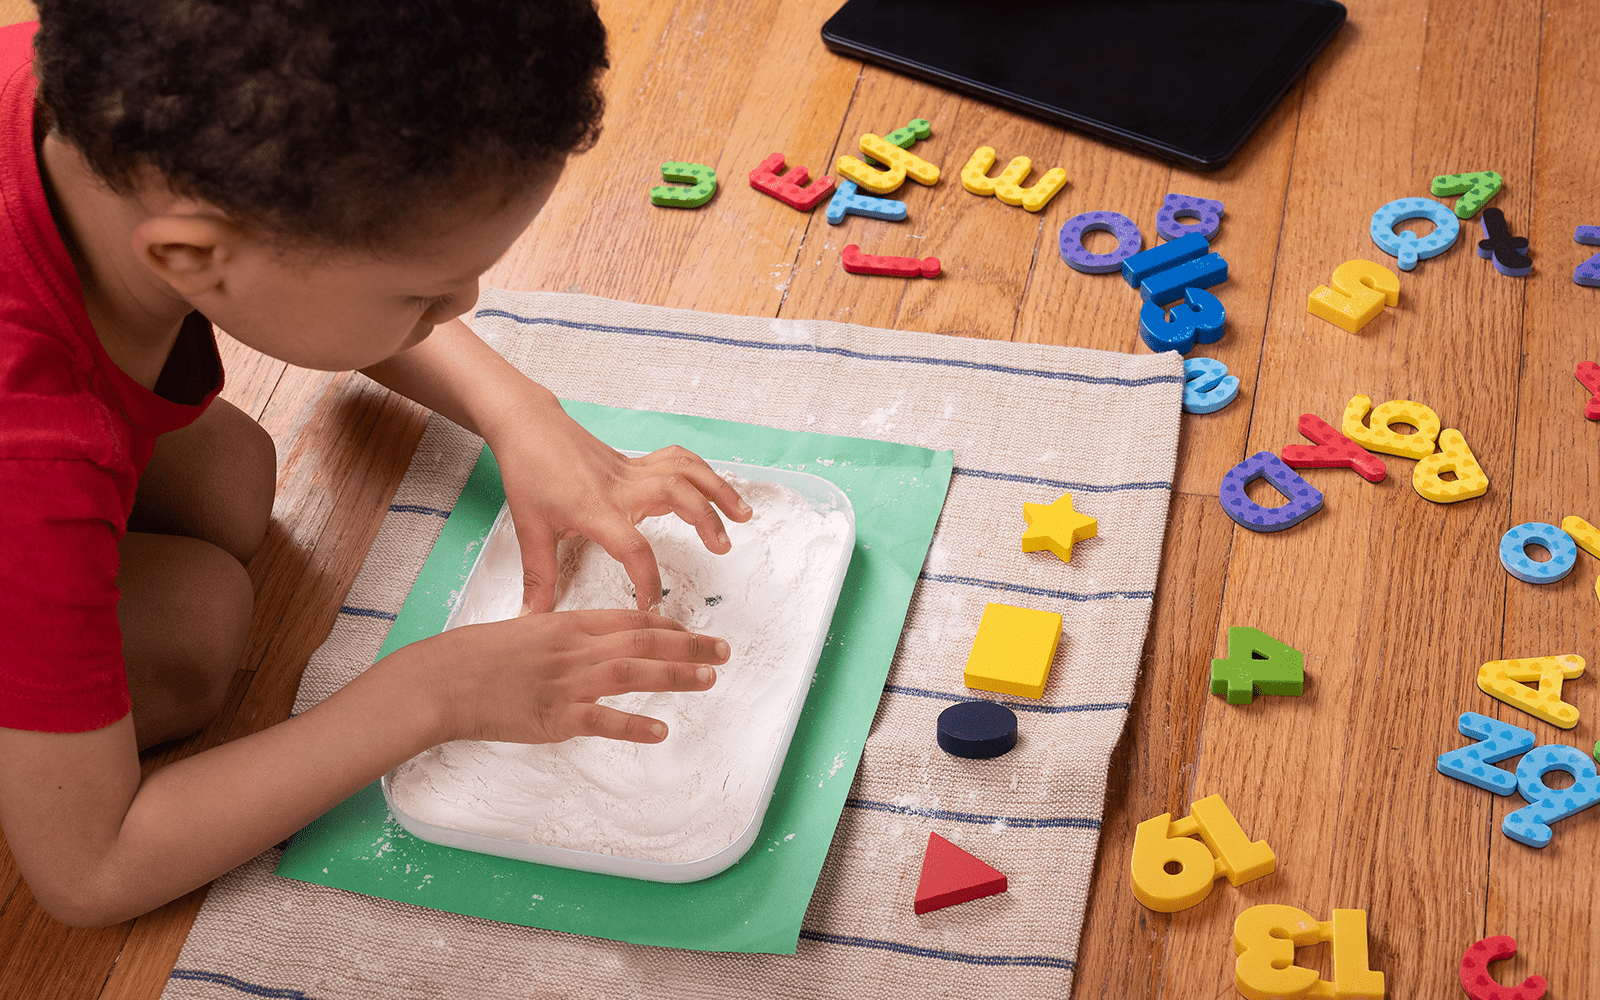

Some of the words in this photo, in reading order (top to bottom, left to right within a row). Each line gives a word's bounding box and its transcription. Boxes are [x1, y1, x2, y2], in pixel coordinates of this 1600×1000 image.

[749, 152, 835, 212] E
[826, 180, 907, 224] T
[1370, 197, 1460, 270] Q
[1219, 451, 1324, 532] D
[1210, 626, 1304, 704] 4
[1477, 654, 1586, 730] A
